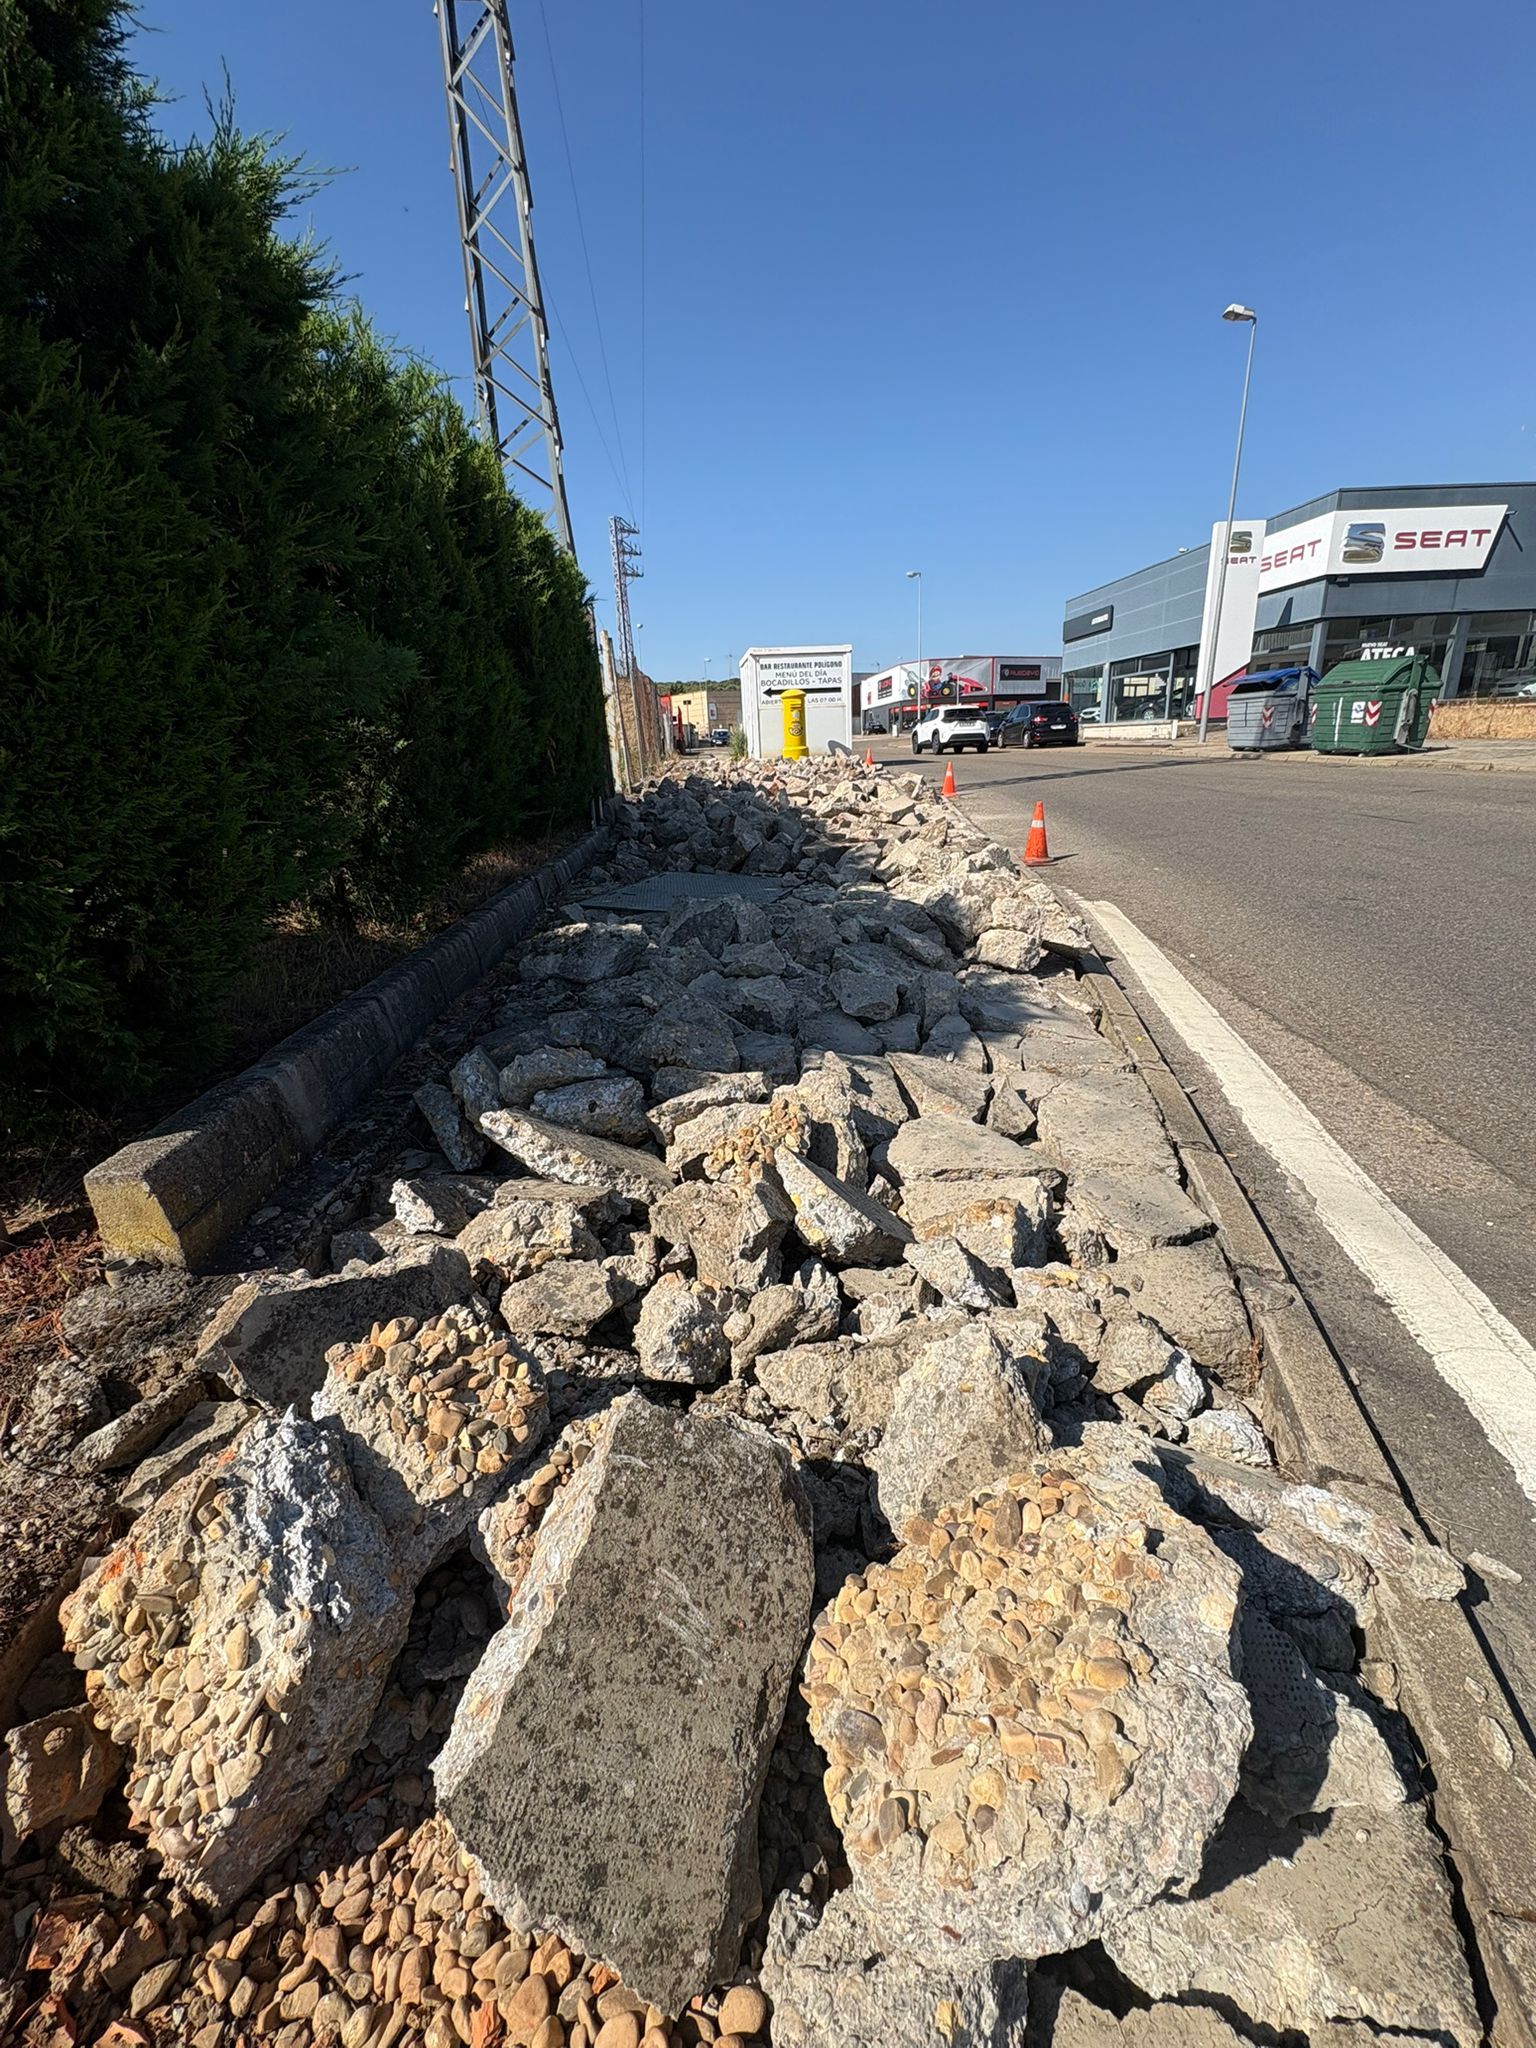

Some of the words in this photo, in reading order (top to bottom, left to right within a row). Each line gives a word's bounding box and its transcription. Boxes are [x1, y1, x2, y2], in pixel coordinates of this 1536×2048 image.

[1394, 528, 1491, 550] SEAT
[1260, 538, 1322, 573] SEAT
[1360, 646, 1415, 661] ATECA
[760, 663, 772, 671] BAR
[773, 661, 813, 670] RESTAURANTE
[775, 670, 798, 678] MENÚ
[799, 670, 813, 678] DEL
[814, 668, 828, 677] DÍA
[760, 678, 810, 686] BOCADILLOS
[818, 676, 842, 684] TAPAS
